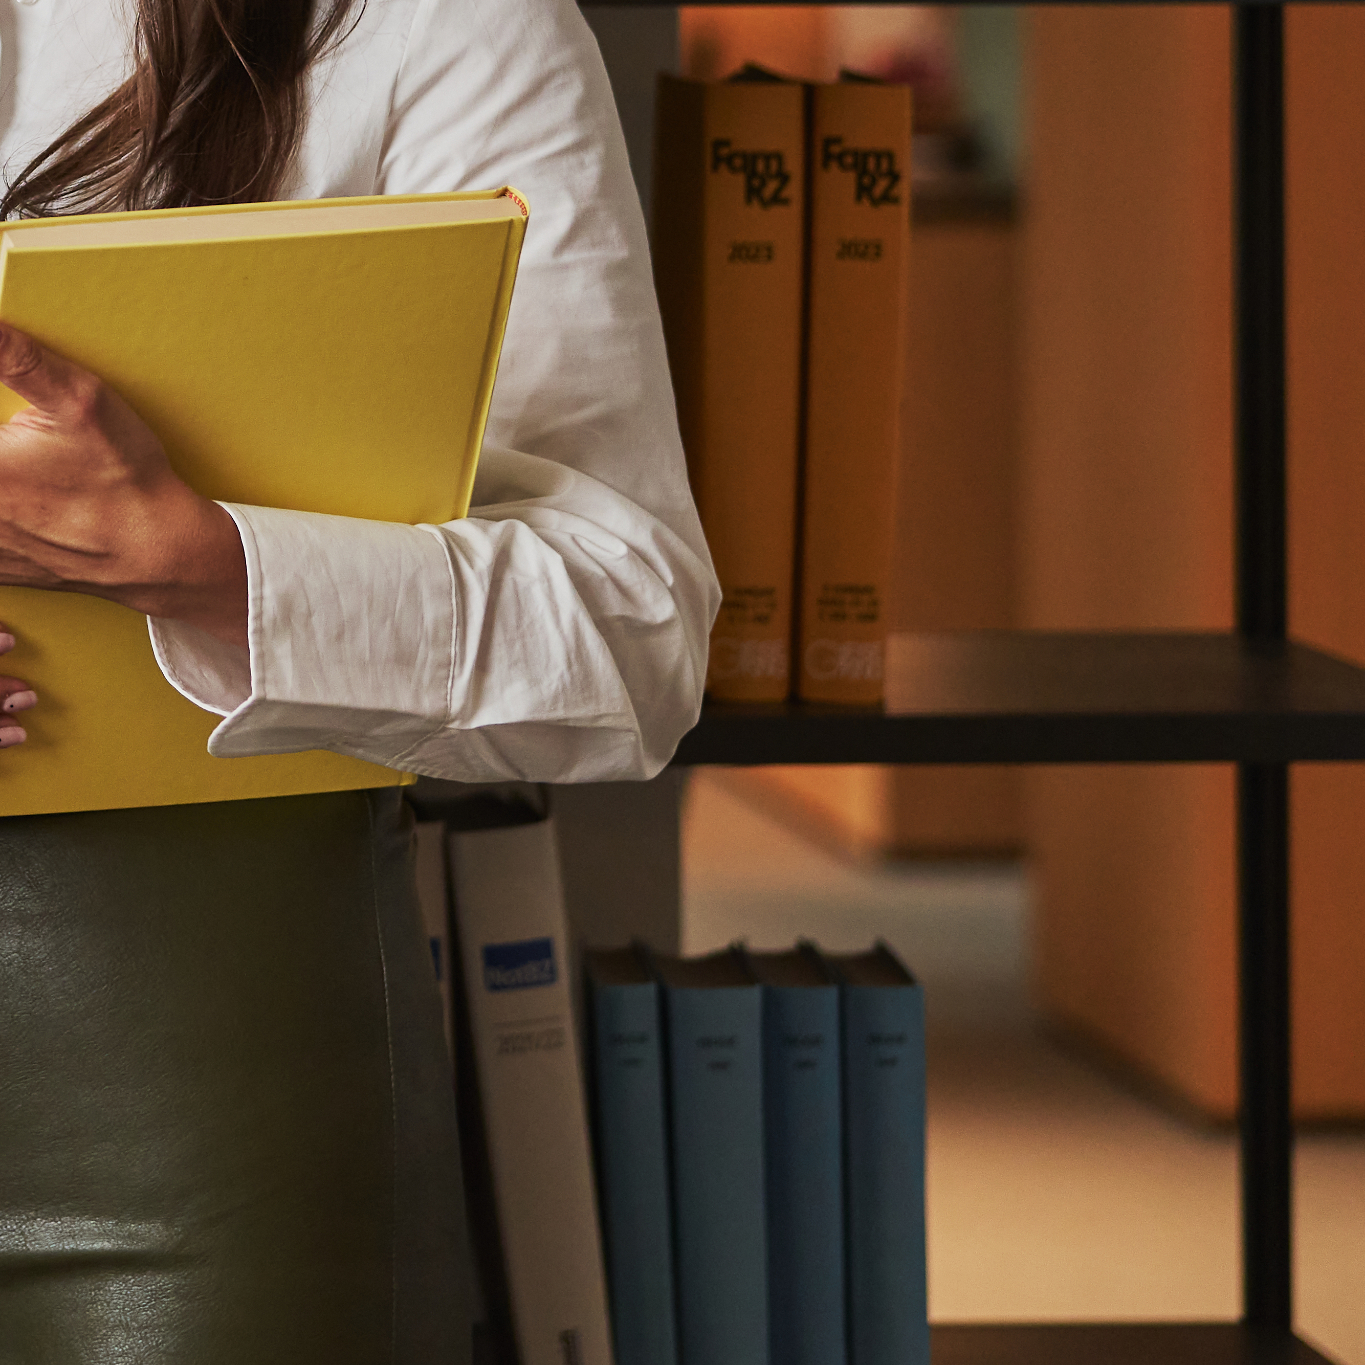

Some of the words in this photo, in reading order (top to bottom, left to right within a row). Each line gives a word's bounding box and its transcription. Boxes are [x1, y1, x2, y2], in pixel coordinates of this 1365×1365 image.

[711, 138, 785, 177] Fam
[822, 135, 896, 175] Fam
[744, 171, 792, 208] RZ
[854, 170, 901, 207] RZ
